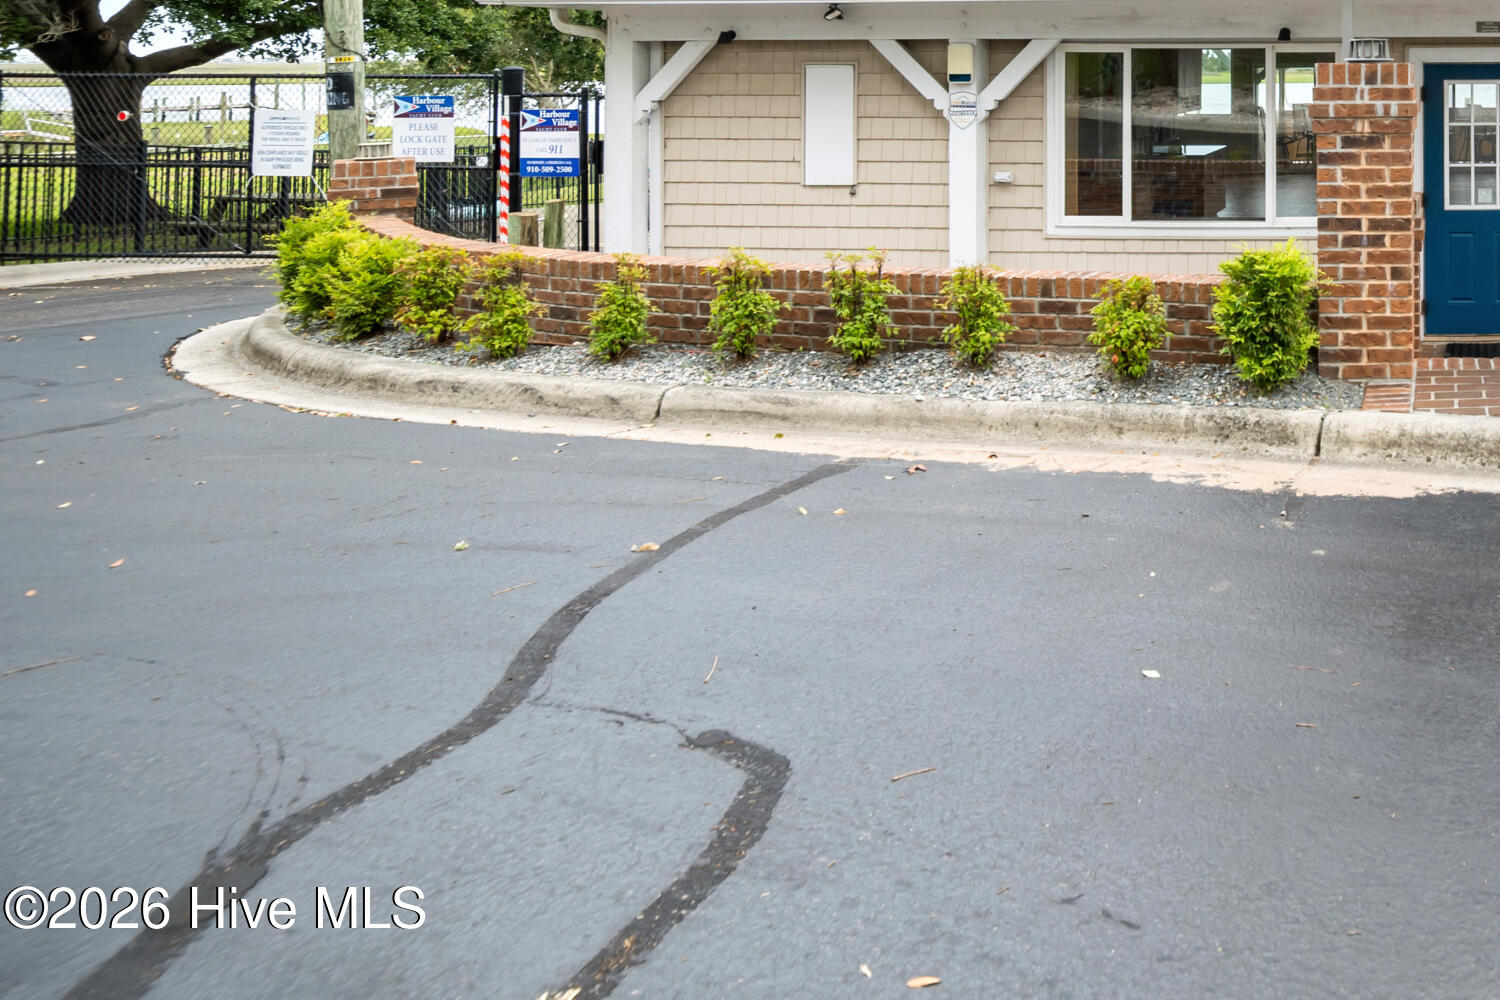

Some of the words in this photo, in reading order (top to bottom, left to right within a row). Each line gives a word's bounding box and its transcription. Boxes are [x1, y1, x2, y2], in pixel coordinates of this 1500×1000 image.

[412, 96, 446, 104] Harbour
[425, 104, 453, 114] Village
[539, 110, 571, 118] Harbour
[408, 122, 439, 131] PLEASE
[551, 118, 577, 128] Village
[399, 135, 423, 144] LOCK
[424, 135, 448, 144] GATE
[400, 147, 428, 156] AFTER
[430, 147, 446, 156] USE
[548, 144, 564, 154] 911
